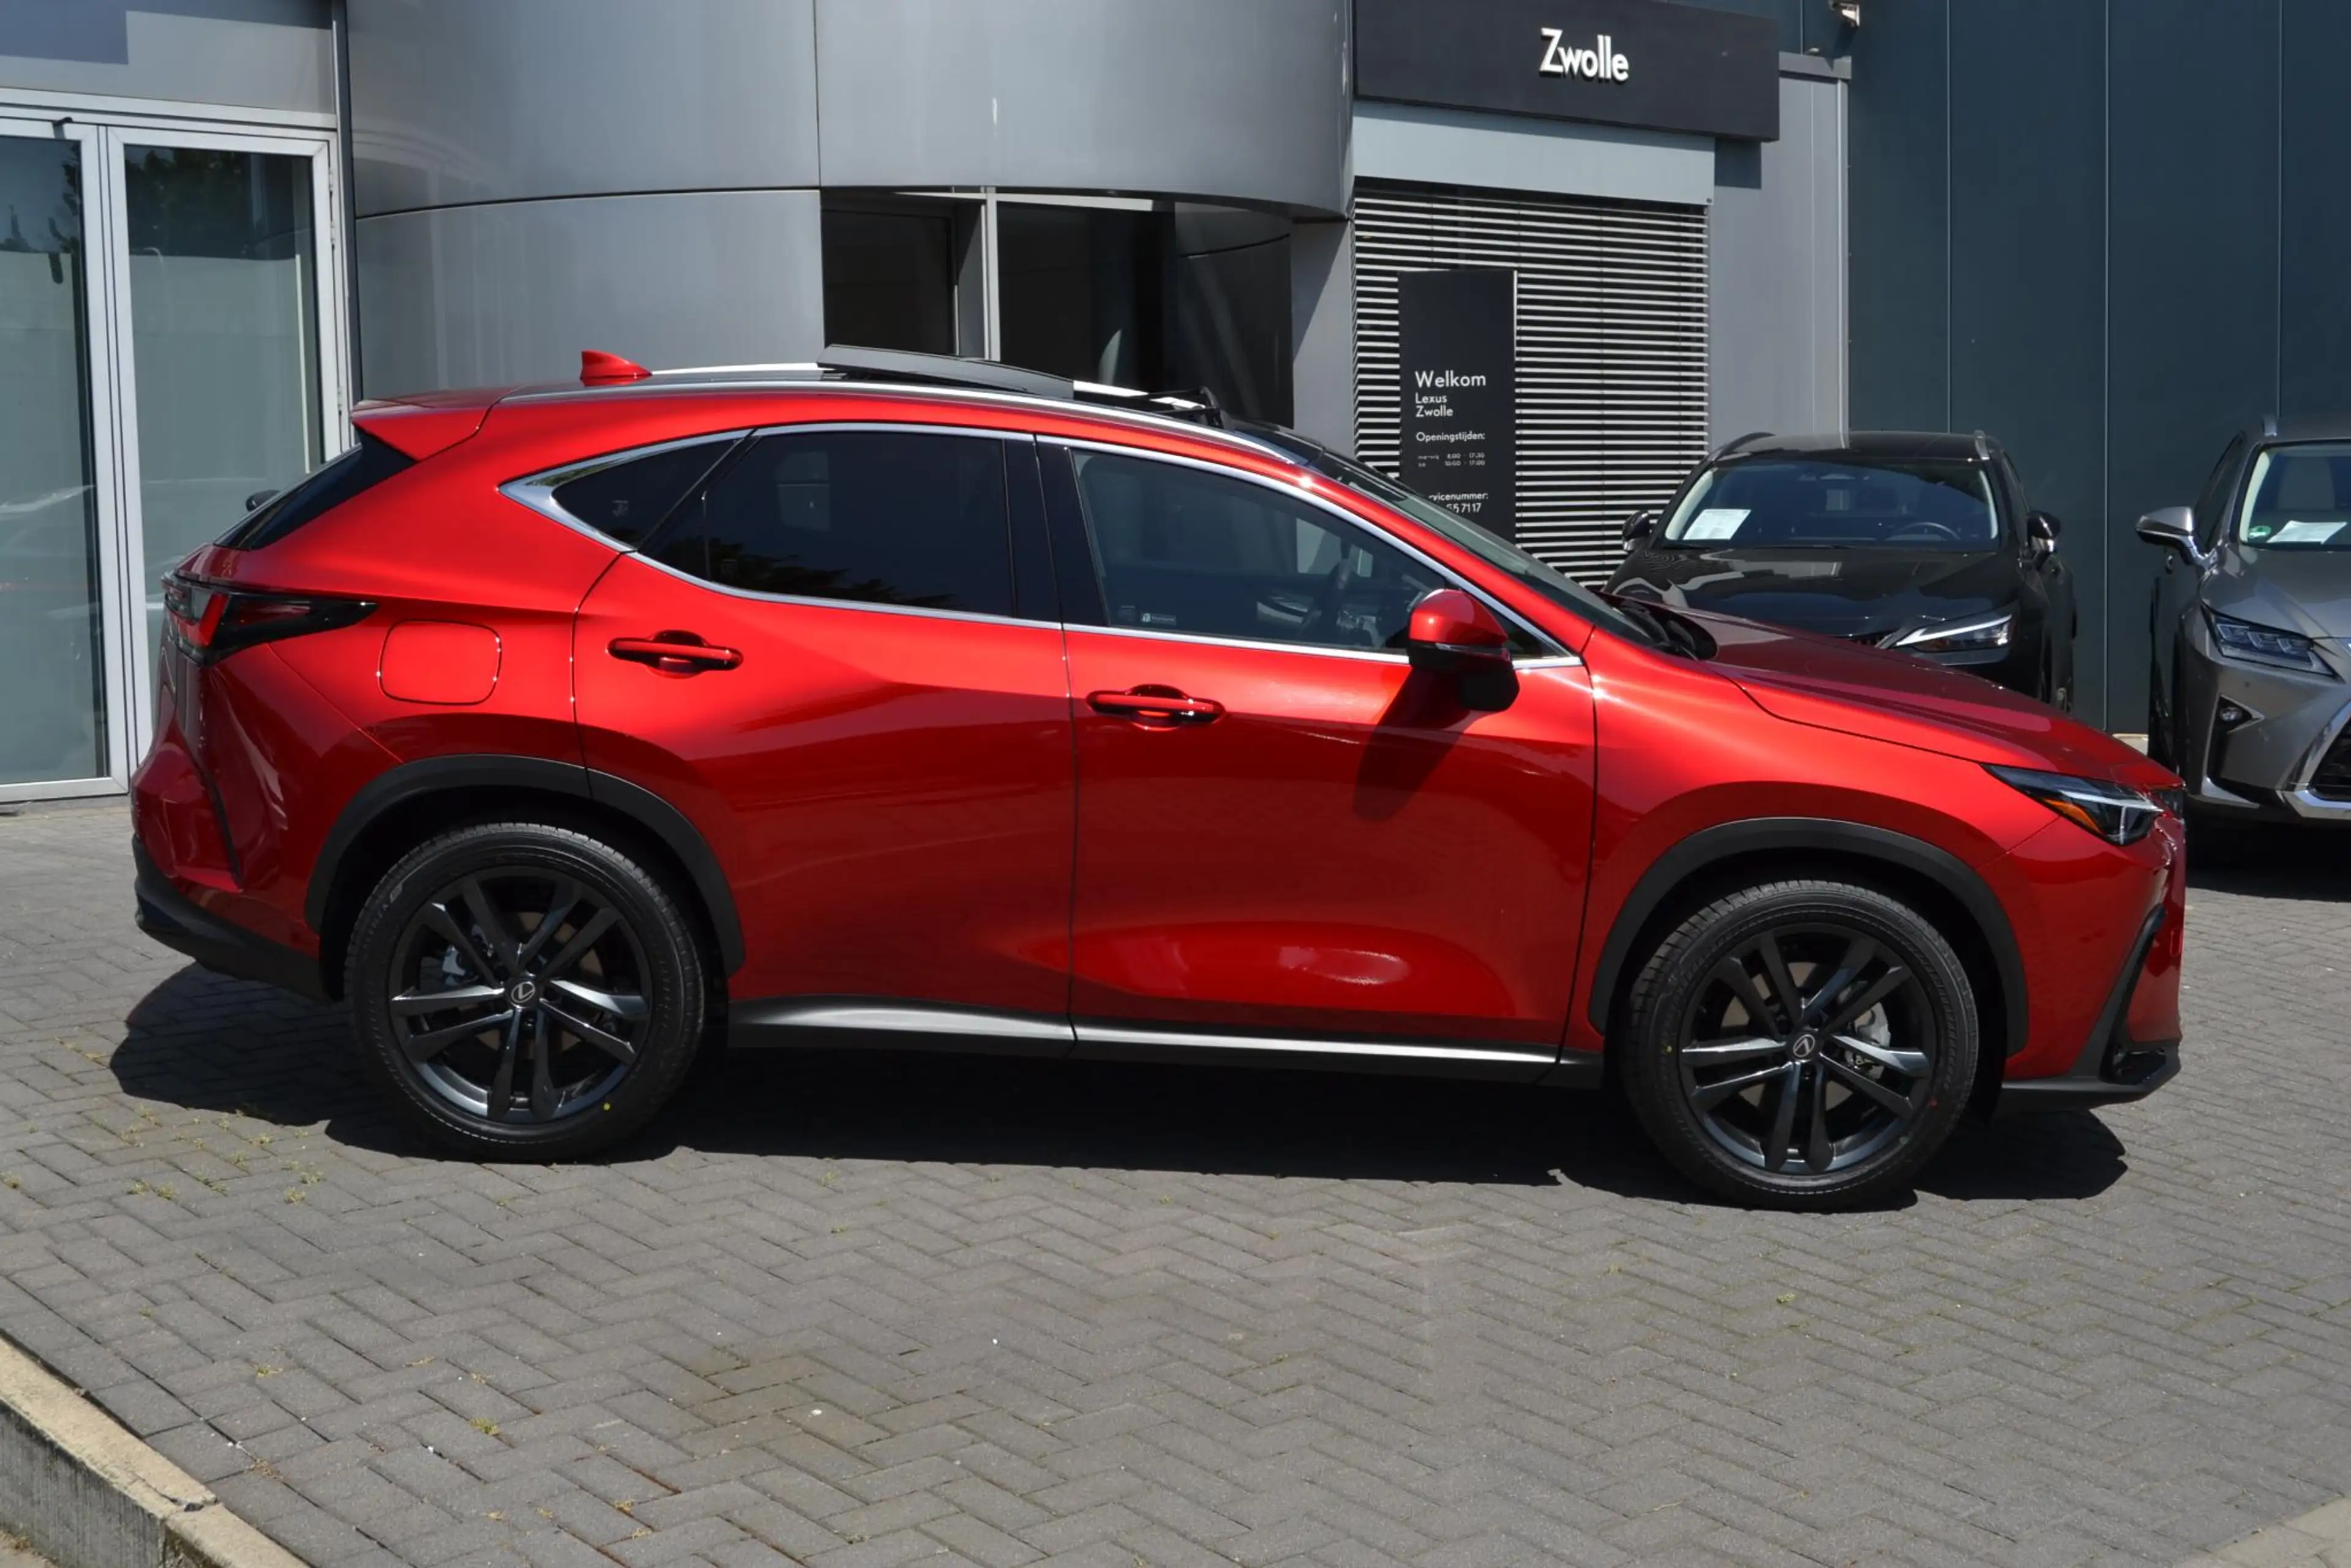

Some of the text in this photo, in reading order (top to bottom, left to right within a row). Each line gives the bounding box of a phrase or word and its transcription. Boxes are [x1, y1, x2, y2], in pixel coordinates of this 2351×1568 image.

[1539, 28, 1629, 81] Zwolle
[1415, 370, 1487, 388] Welkom
[1415, 392, 1447, 404] Lexus
[1415, 405, 1453, 418] Zwolle
[1415, 430, 1485, 443] Openingstijden:
